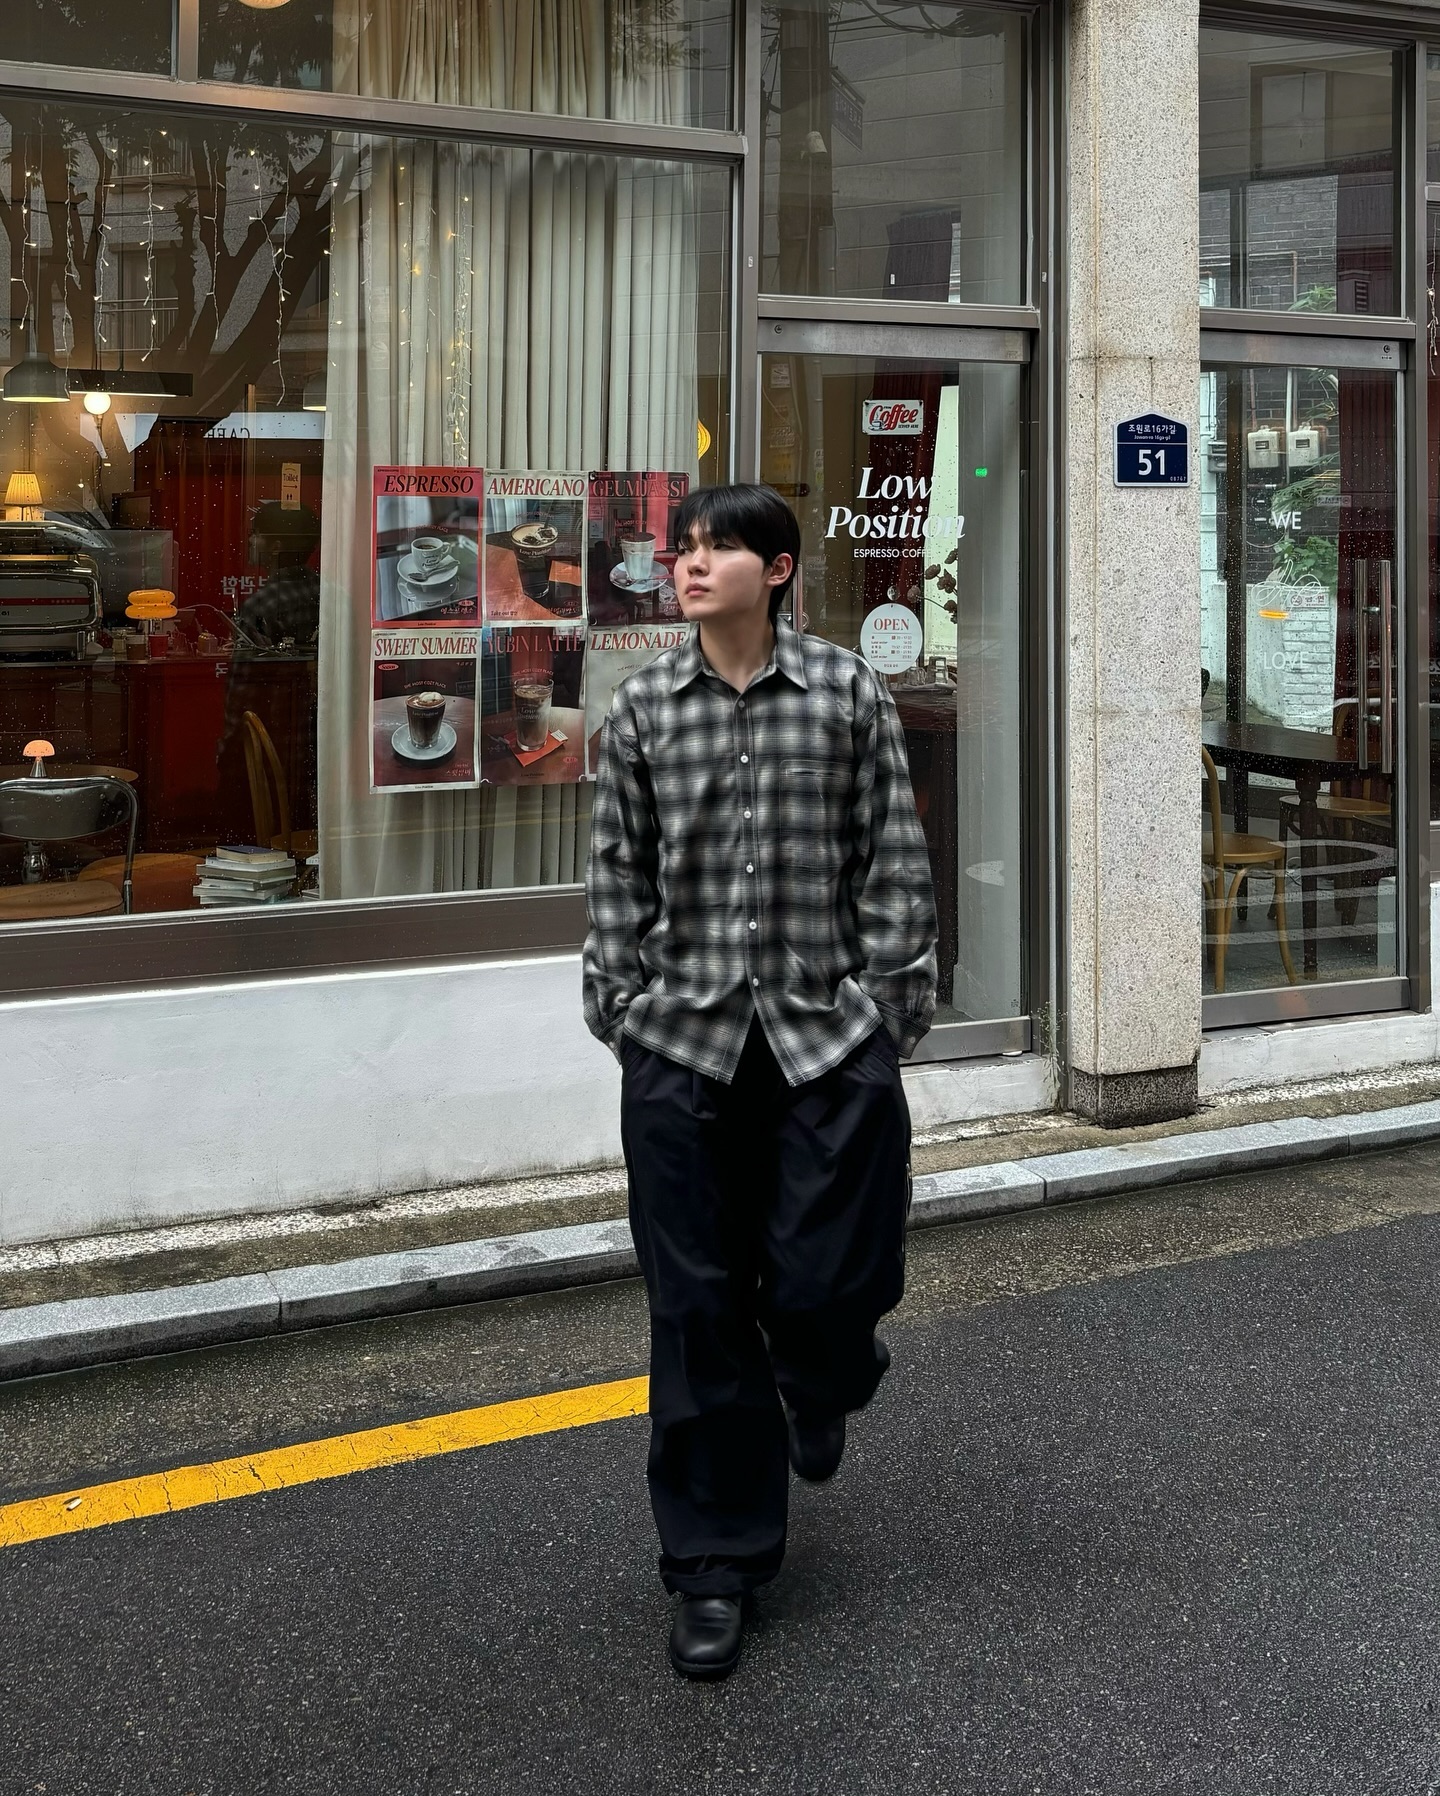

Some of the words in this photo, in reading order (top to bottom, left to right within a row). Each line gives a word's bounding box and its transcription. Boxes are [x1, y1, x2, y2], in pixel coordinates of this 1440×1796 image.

[869, 404, 919, 430] Coffee
[1128, 424, 1176, 434] 조원로16가길
[1138, 449, 1165, 476] 51
[283, 473, 299, 482] Toilet
[384, 475, 474, 494] ESPRESSO
[487, 478, 585, 496] AMERICANO
[857, 467, 935, 499] Low
[593, 480, 685, 497] GEUMJASSI
[824, 505, 966, 538] Position
[1271, 511, 1302, 530] WE
[853, 548, 900, 558] ESPRESSO
[873, 618, 909, 630] OPEN
[375, 638, 419, 656] SWEET
[421, 637, 478, 655] SUMMER
[486, 635, 530, 654] YUBIN
[534, 634, 581, 652] LATTE
[1263, 652, 1310, 669] LOVE
